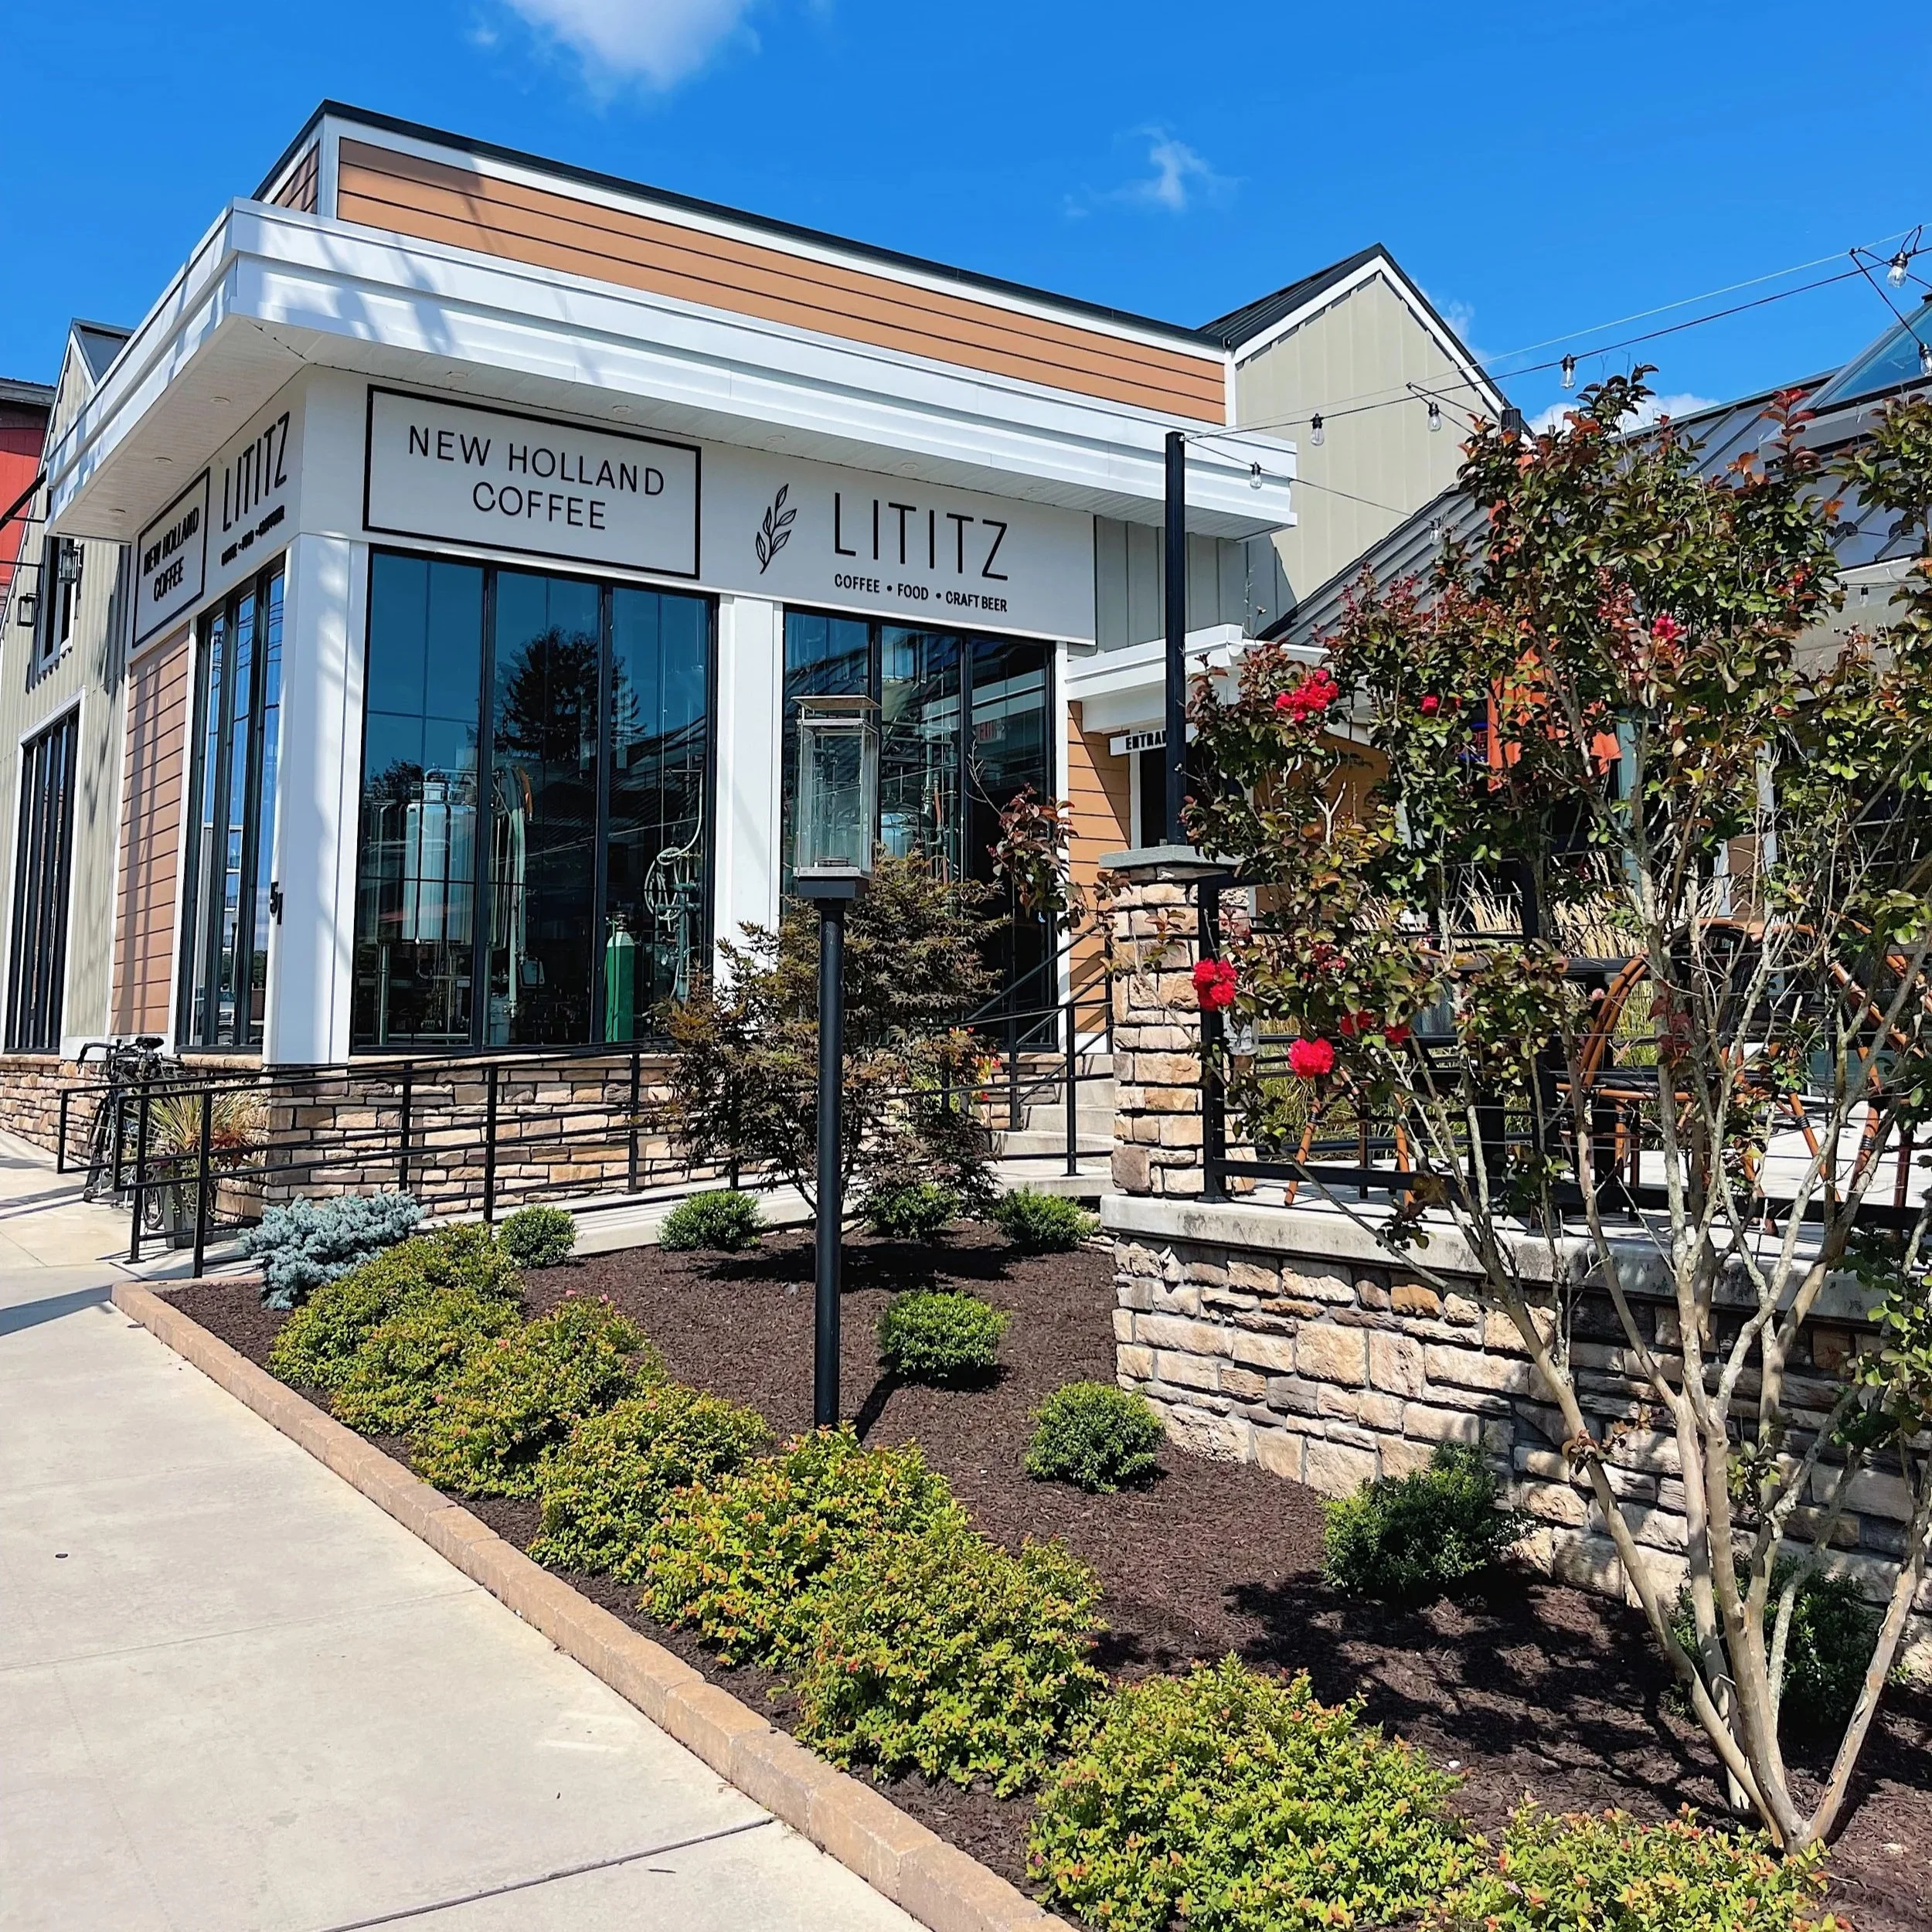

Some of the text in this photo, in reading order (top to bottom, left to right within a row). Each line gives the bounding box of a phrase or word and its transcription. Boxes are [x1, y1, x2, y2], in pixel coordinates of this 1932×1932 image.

[223, 411, 290, 532] LITITZ
[409, 425, 664, 495] NEW HOLLAND
[473, 482, 606, 529] COFFEE
[162, 507, 199, 560] HOLLAND
[835, 492, 1008, 581] LITITZ
[154, 556, 184, 601] COFFEE
[835, 573, 1008, 612] COFFEE FOOD CRAFT BEER
[1125, 730, 1167, 750] ENTRAN
[270, 881, 284, 925] 51
